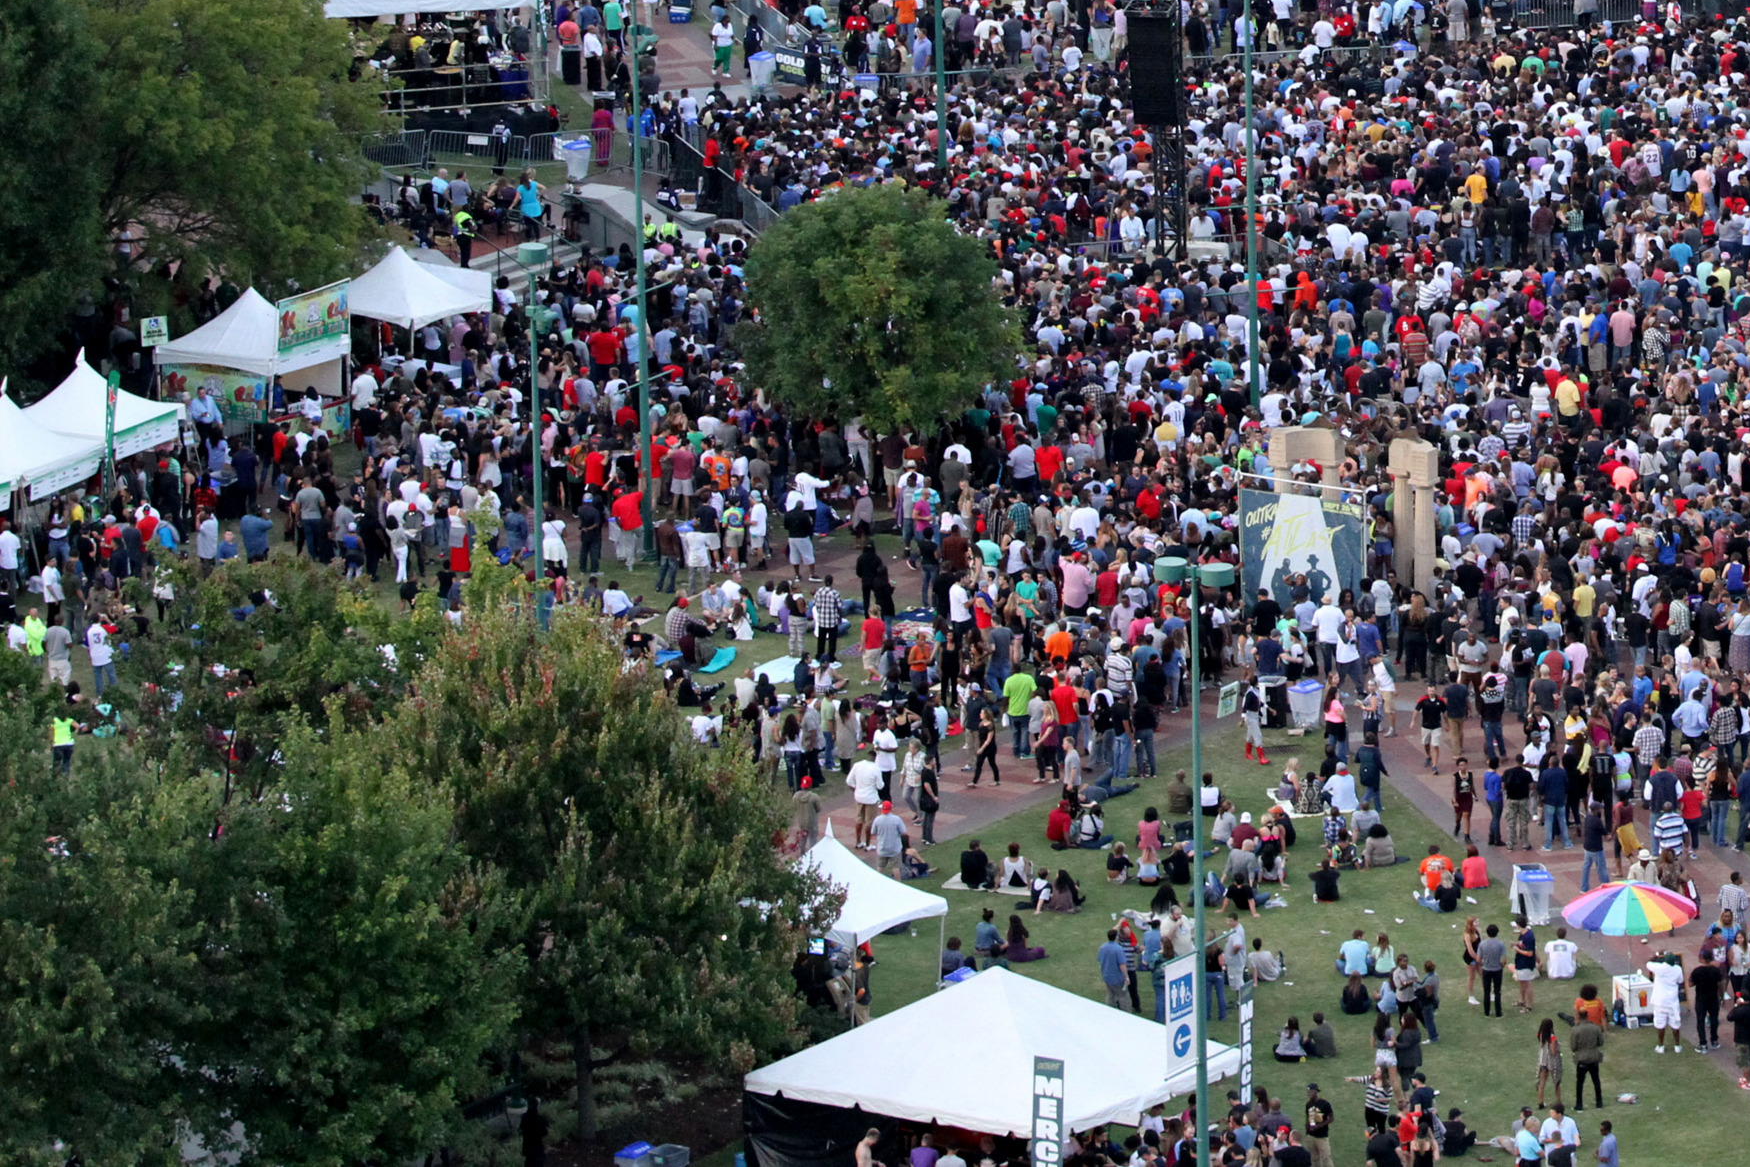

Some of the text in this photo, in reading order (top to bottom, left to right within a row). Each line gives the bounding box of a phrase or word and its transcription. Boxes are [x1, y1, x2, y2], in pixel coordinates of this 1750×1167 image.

[776, 53, 806, 67] GOLD
[1647, 153, 1659, 164] 22
[1516, 374, 1525, 387] 7
[1245, 501, 1284, 527] OUTKA
[1240, 999, 1254, 1106] MERCH
[1035, 1074, 1063, 1167] MERC
